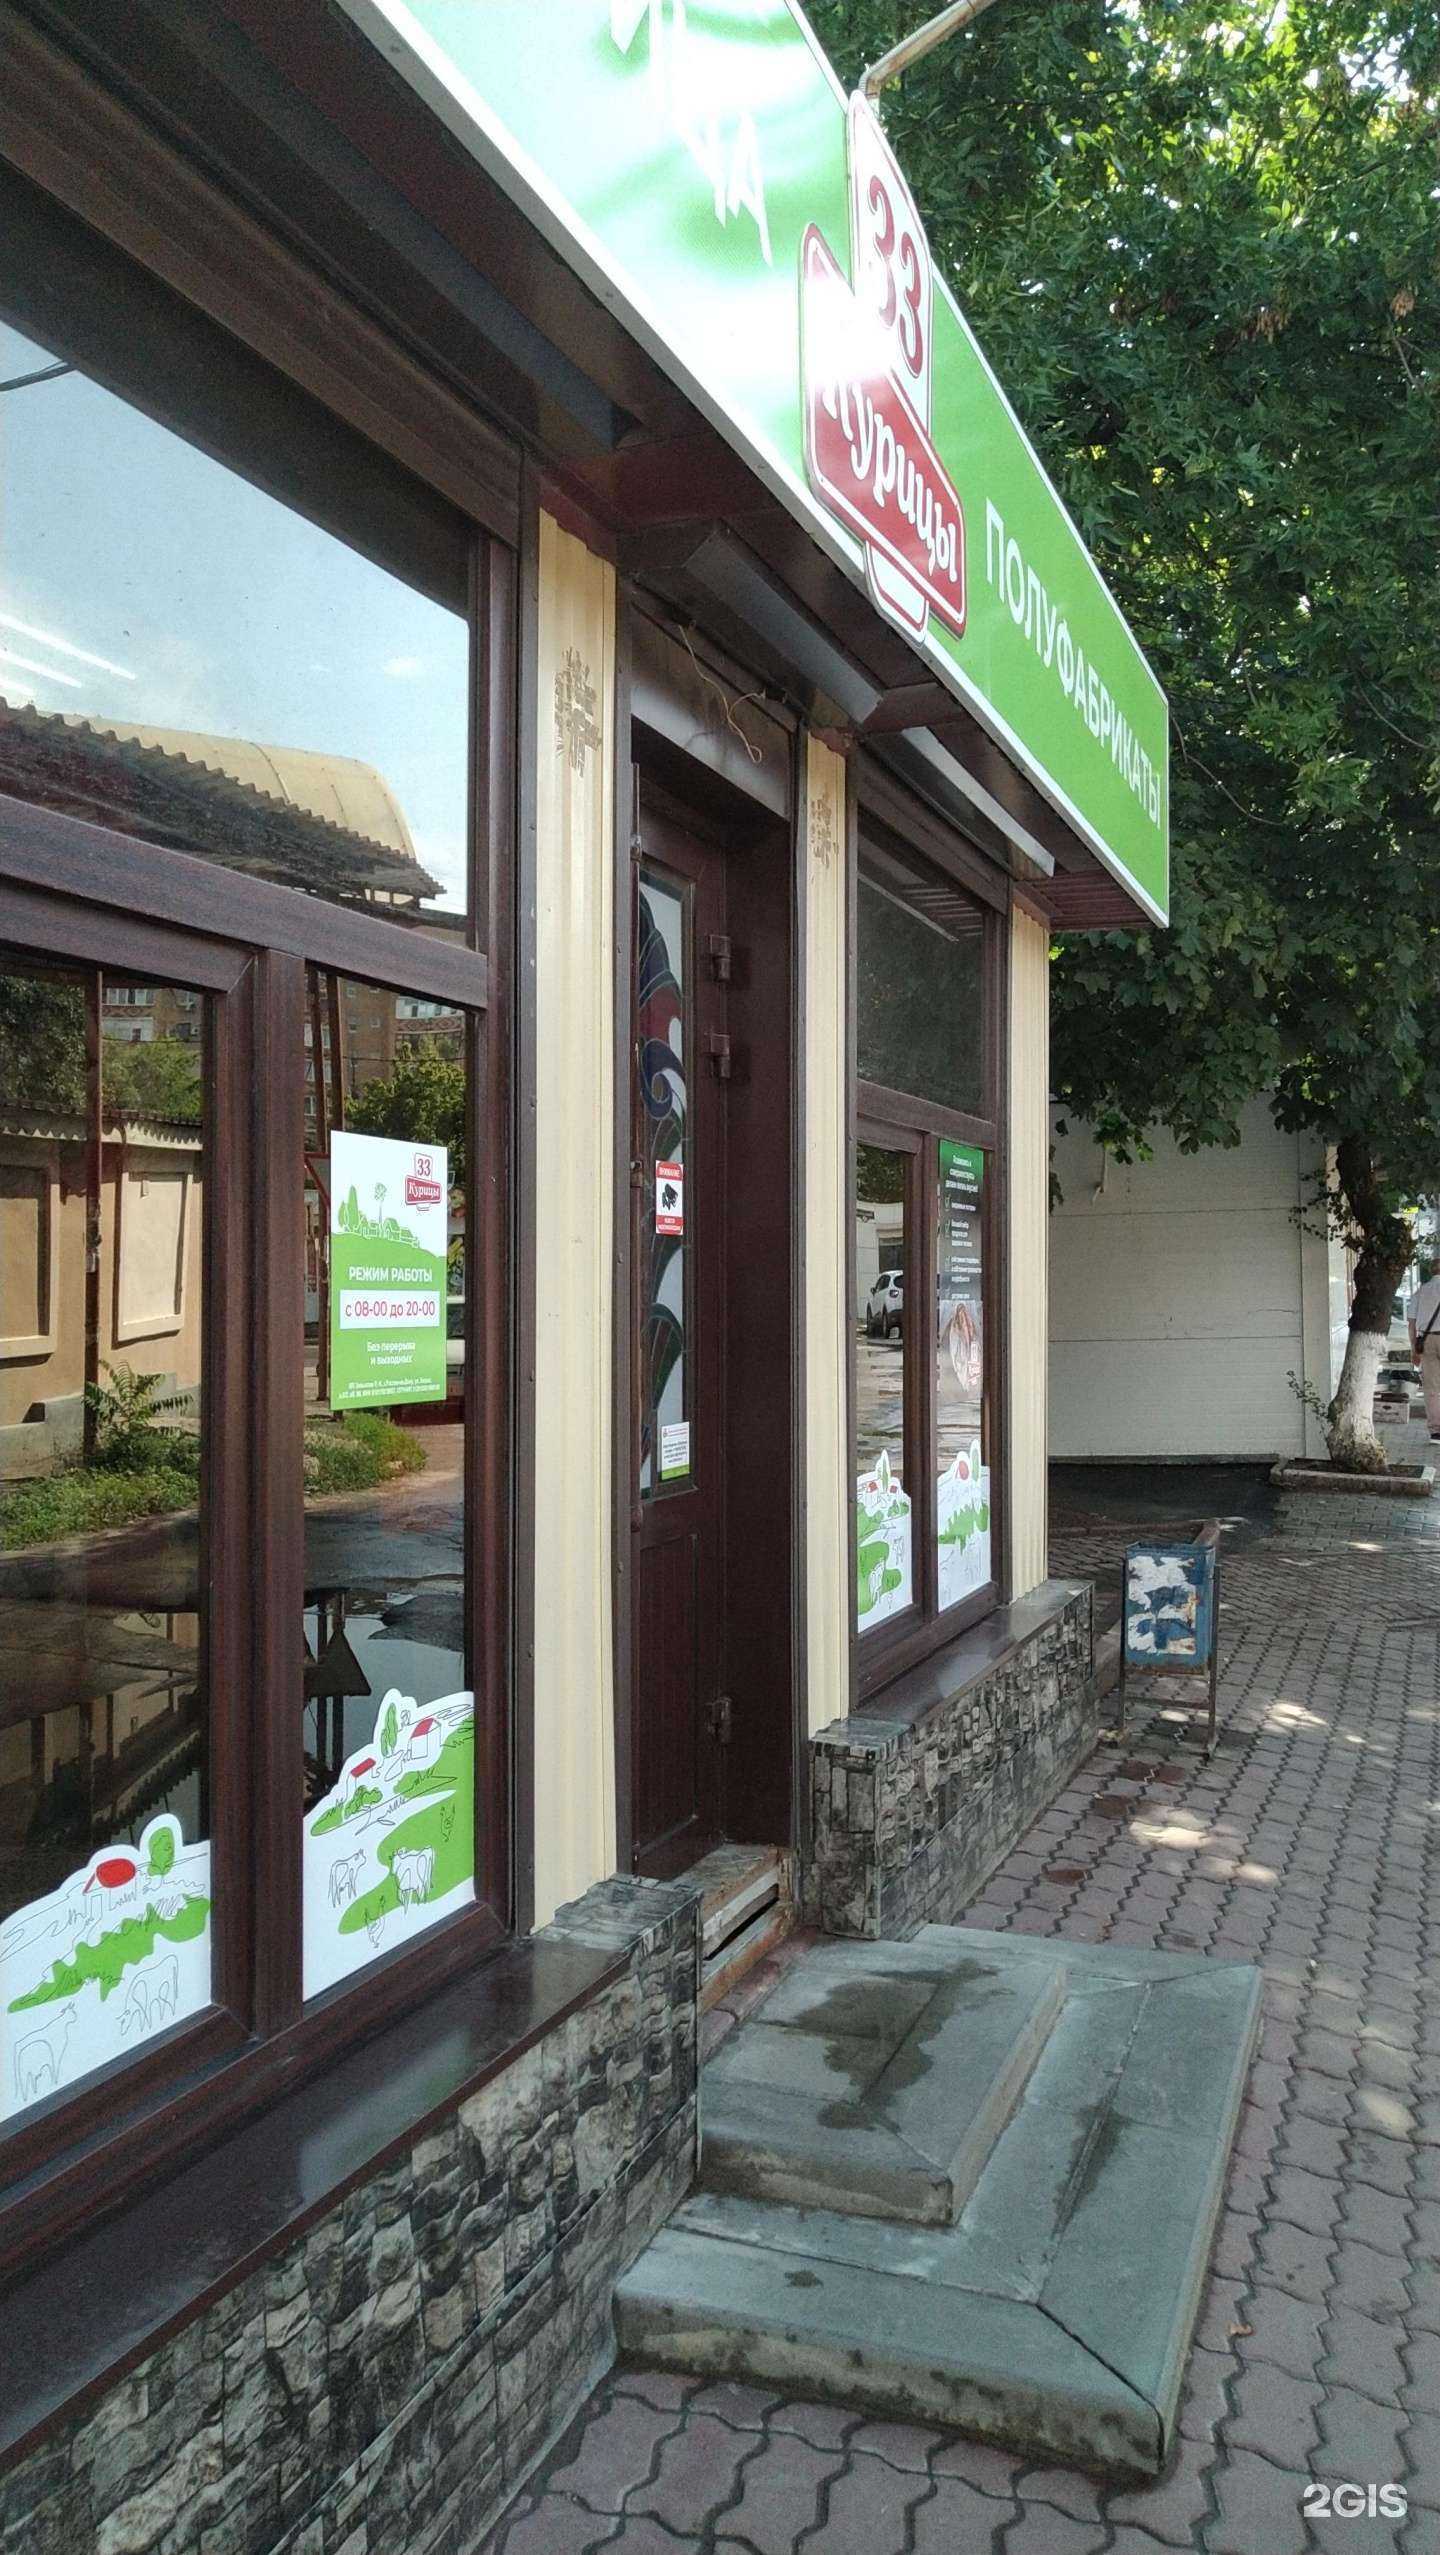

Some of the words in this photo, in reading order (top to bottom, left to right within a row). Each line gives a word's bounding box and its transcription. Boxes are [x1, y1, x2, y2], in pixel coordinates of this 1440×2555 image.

[869, 175, 924, 379] 33
[985, 496, 1161, 830] ПОЛУФАБРИКАТЫ
[417, 1158, 432, 1177] 33
[409, 1181, 440, 1199] Курицы
[348, 1266, 389, 1282] РЕЖИМ
[391, 1267, 433, 1283] РАБОТЫ
[345, 1304, 352, 1317] с
[354, 1300, 388, 1317] 08-00
[390, 1304, 404, 1319] до
[406, 1300, 436, 1317] 20-00
[367, 1341, 381, 1352] Без
